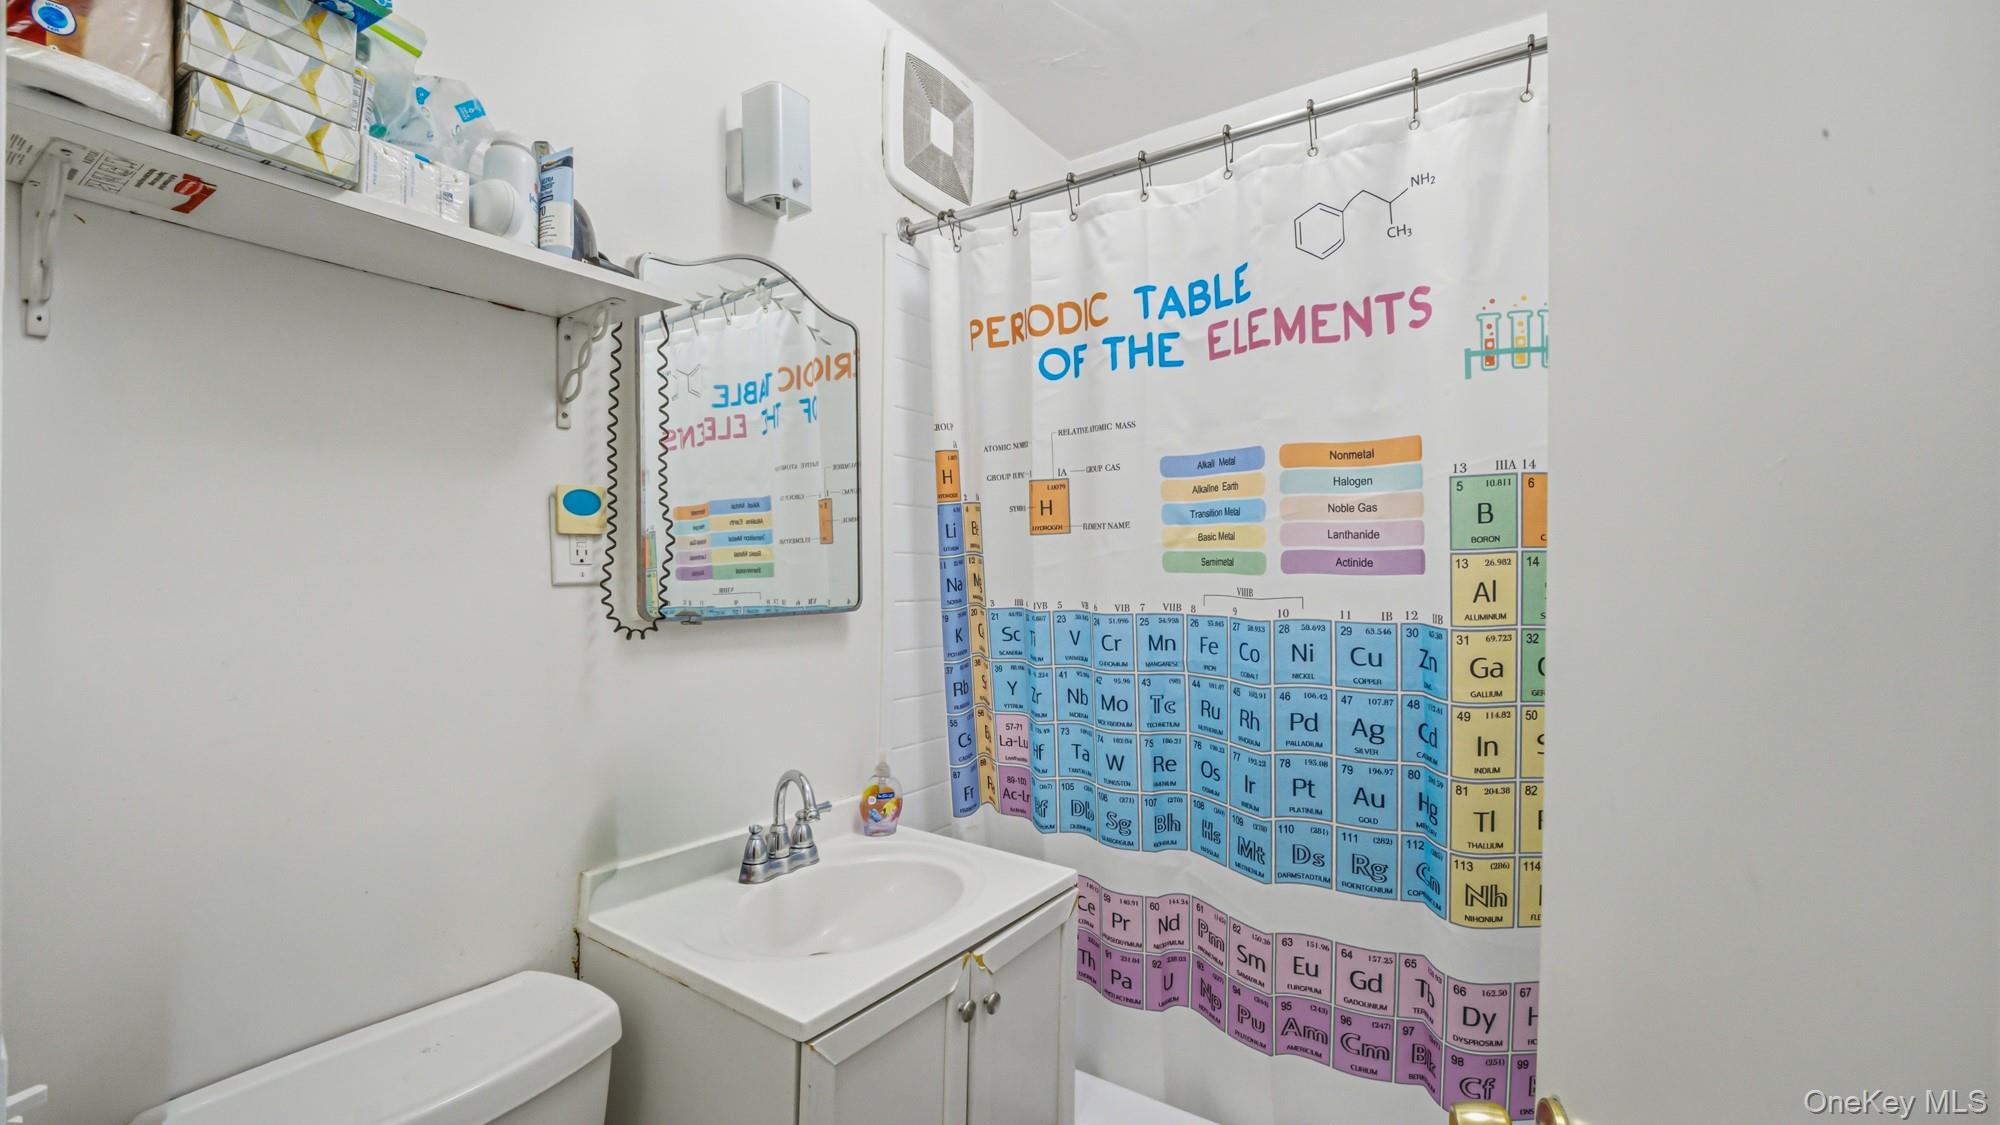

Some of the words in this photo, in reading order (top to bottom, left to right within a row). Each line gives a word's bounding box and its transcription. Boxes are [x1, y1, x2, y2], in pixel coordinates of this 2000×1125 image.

[970, 292, 1108, 351] PERIODIC
[1134, 262, 1251, 320] TABLE
[1038, 344, 1087, 380] OF
[1103, 331, 1184, 371] THE
[1207, 286, 1433, 361] ELEMENTS
[1116, 420, 1136, 430] MASS
[1329, 449, 1374, 460] Nonmetal
[1105, 463, 1121, 472] CAS
[1197, 460, 1215, 471] Alkali
[1219, 456, 1236, 467] Metal
[1453, 463, 1467, 474] 13
[1495, 459, 1517, 471] IIIA
[1522, 458, 1536, 470] 14
[942, 469, 953, 485] H
[1333, 477, 1373, 488] Halogen
[1486, 478, 1512, 488] 10.811
[1527, 477, 1535, 488] 6
[1192, 483, 1219, 494] Alkaline
[1222, 481, 1239, 492] Earth
[1456, 480, 1464, 492] 5
[1040, 500, 1053, 516] H
[1190, 508, 1224, 519] Transition
[1224, 507, 1241, 517] Metal
[1327, 503, 1355, 513] Noble
[1357, 503, 1378, 513] Gas
[1477, 502, 1494, 525] B
[946, 522, 957, 539] Li
[1107, 521, 1130, 530] NAME
[1197, 532, 1217, 542] Basic
[1218, 531, 1236, 541] Metal
[1327, 529, 1380, 540] Lanthanide
[1471, 535, 1501, 544] BORON
[1201, 557, 1234, 567] Semimetal
[1335, 557, 1374, 568] Actinide
[1456, 558, 1469, 569] 13
[1526, 556, 1540, 567] 14
[947, 577, 963, 593] Na
[1472, 579, 1497, 604] Al
[1237, 587, 1254, 598] VIIIB
[1115, 604, 1130, 612] VIB
[1278, 608, 1290, 618] 10
[1056, 614, 1067, 624] 23
[1340, 610, 1351, 620] 11
[1405, 610, 1418, 620] 12
[1139, 617, 1149, 627] 25
[1232, 622, 1240, 632] 27
[955, 627, 963, 644] K
[1001, 626, 1021, 642] Sc
[1278, 624, 1290, 634] 28
[1340, 626, 1352, 636] 29
[1406, 628, 1419, 638] 30
[1069, 630, 1081, 646] V
[1101, 634, 1122, 652] Cr
[1148, 634, 1176, 652] Mn
[1456, 635, 1470, 646] 31
[1525, 633, 1540, 644] 32
[1199, 636, 1219, 655] Fe
[1239, 642, 1260, 663] Co
[1291, 643, 1315, 663] Ni
[1350, 646, 1382, 667] Cu
[1419, 648, 1438, 673] Zn
[1469, 657, 1504, 679] Ga
[953, 680, 969, 697] Rb
[1007, 680, 1018, 696] Y
[1141, 678, 1151, 687] 43
[1067, 687, 1089, 706] Nb
[1233, 687, 1241, 697] 45
[1279, 691, 1291, 701] 46
[1470, 690, 1503, 698] GALLIUM
[1101, 694, 1129, 712] Mo
[1150, 694, 1176, 714] Tc
[1340, 695, 1353, 705] 47
[1407, 699, 1420, 710] 48
[1200, 699, 1221, 720] Ru
[1525, 709, 1538, 721] 50
[1240, 708, 1260, 730] Rh
[1290, 712, 1319, 732] Pd
[1456, 711, 1471, 722] 49
[1060, 727, 1070, 736] 73
[1351, 718, 1385, 745] Ag
[1418, 722, 1438, 748] Cd
[958, 732, 972, 748] Cs
[1477, 736, 1499, 757] In
[1071, 743, 1090, 762] Ta
[1105, 753, 1125, 772] W
[1153, 755, 1177, 773] Re
[1279, 758, 1291, 768] 78
[1200, 760, 1221, 782] Os
[1341, 764, 1354, 775] 79
[1407, 769, 1421, 780] 80
[1061, 783, 1075, 792] 105
[1244, 774, 1257, 794] Ir
[1292, 778, 1316, 798] Pt
[1455, 784, 1468, 796] 81
[1525, 785, 1538, 796] 82
[1144, 798, 1157, 808] 107
[1352, 787, 1385, 809] Au
[1418, 791, 1438, 826] Hg
[1105, 810, 1132, 837] Sg
[1154, 813, 1181, 834] Bh
[1358, 816, 1379, 825] GOLD
[1473, 810, 1495, 833] Tl
[1278, 824, 1295, 834] 110
[1342, 832, 1358, 844] 111
[1406, 839, 1425, 851] 112
[1467, 841, 1504, 849] THALLIUM
[1292, 843, 1326, 868] Ds
[1351, 853, 1389, 884] Rg
[1454, 859, 1474, 872] 113
[1523, 861, 1541, 871] 114
[1277, 871, 1331, 884] DARMSTADTIUM
[1341, 880, 1393, 895] ROENTGENIUM
[1464, 883, 1508, 908] Nh
[1077, 895, 1096, 916] Ce
[1149, 902, 1160, 911] 60
[1111, 912, 1131, 931] Pr
[1158, 913, 1181, 935] Nd
[1464, 914, 1504, 923] NIHONIUM
[1281, 937, 1294, 948] 63
[1236, 944, 1266, 974] Sm
[1340, 948, 1353, 960] 64
[1293, 955, 1319, 978] Eu
[1404, 958, 1418, 969] 65
[1111, 968, 1133, 990] Pa
[1163, 972, 1174, 992] U
[1350, 970, 1383, 994] Gd
[1414, 978, 1435, 1009] Tb
[1453, 984, 1467, 997] 66
[1519, 987, 1532, 998] 67
[1280, 1001, 1293, 1012] 95
[1343, 996, 1388, 1011] GADOLINIUM
[1236, 1003, 1266, 1034] Pu
[1340, 1015, 1353, 1026] 96
[1462, 1006, 1497, 1034] Dy
[1280, 1017, 1329, 1046] Am
[1402, 1026, 1416, 1037] 97
[1340, 1032, 1390, 1062] Cm
[1451, 1054, 1465, 1067] 98
[1516, 1059, 1529, 1070] 99
